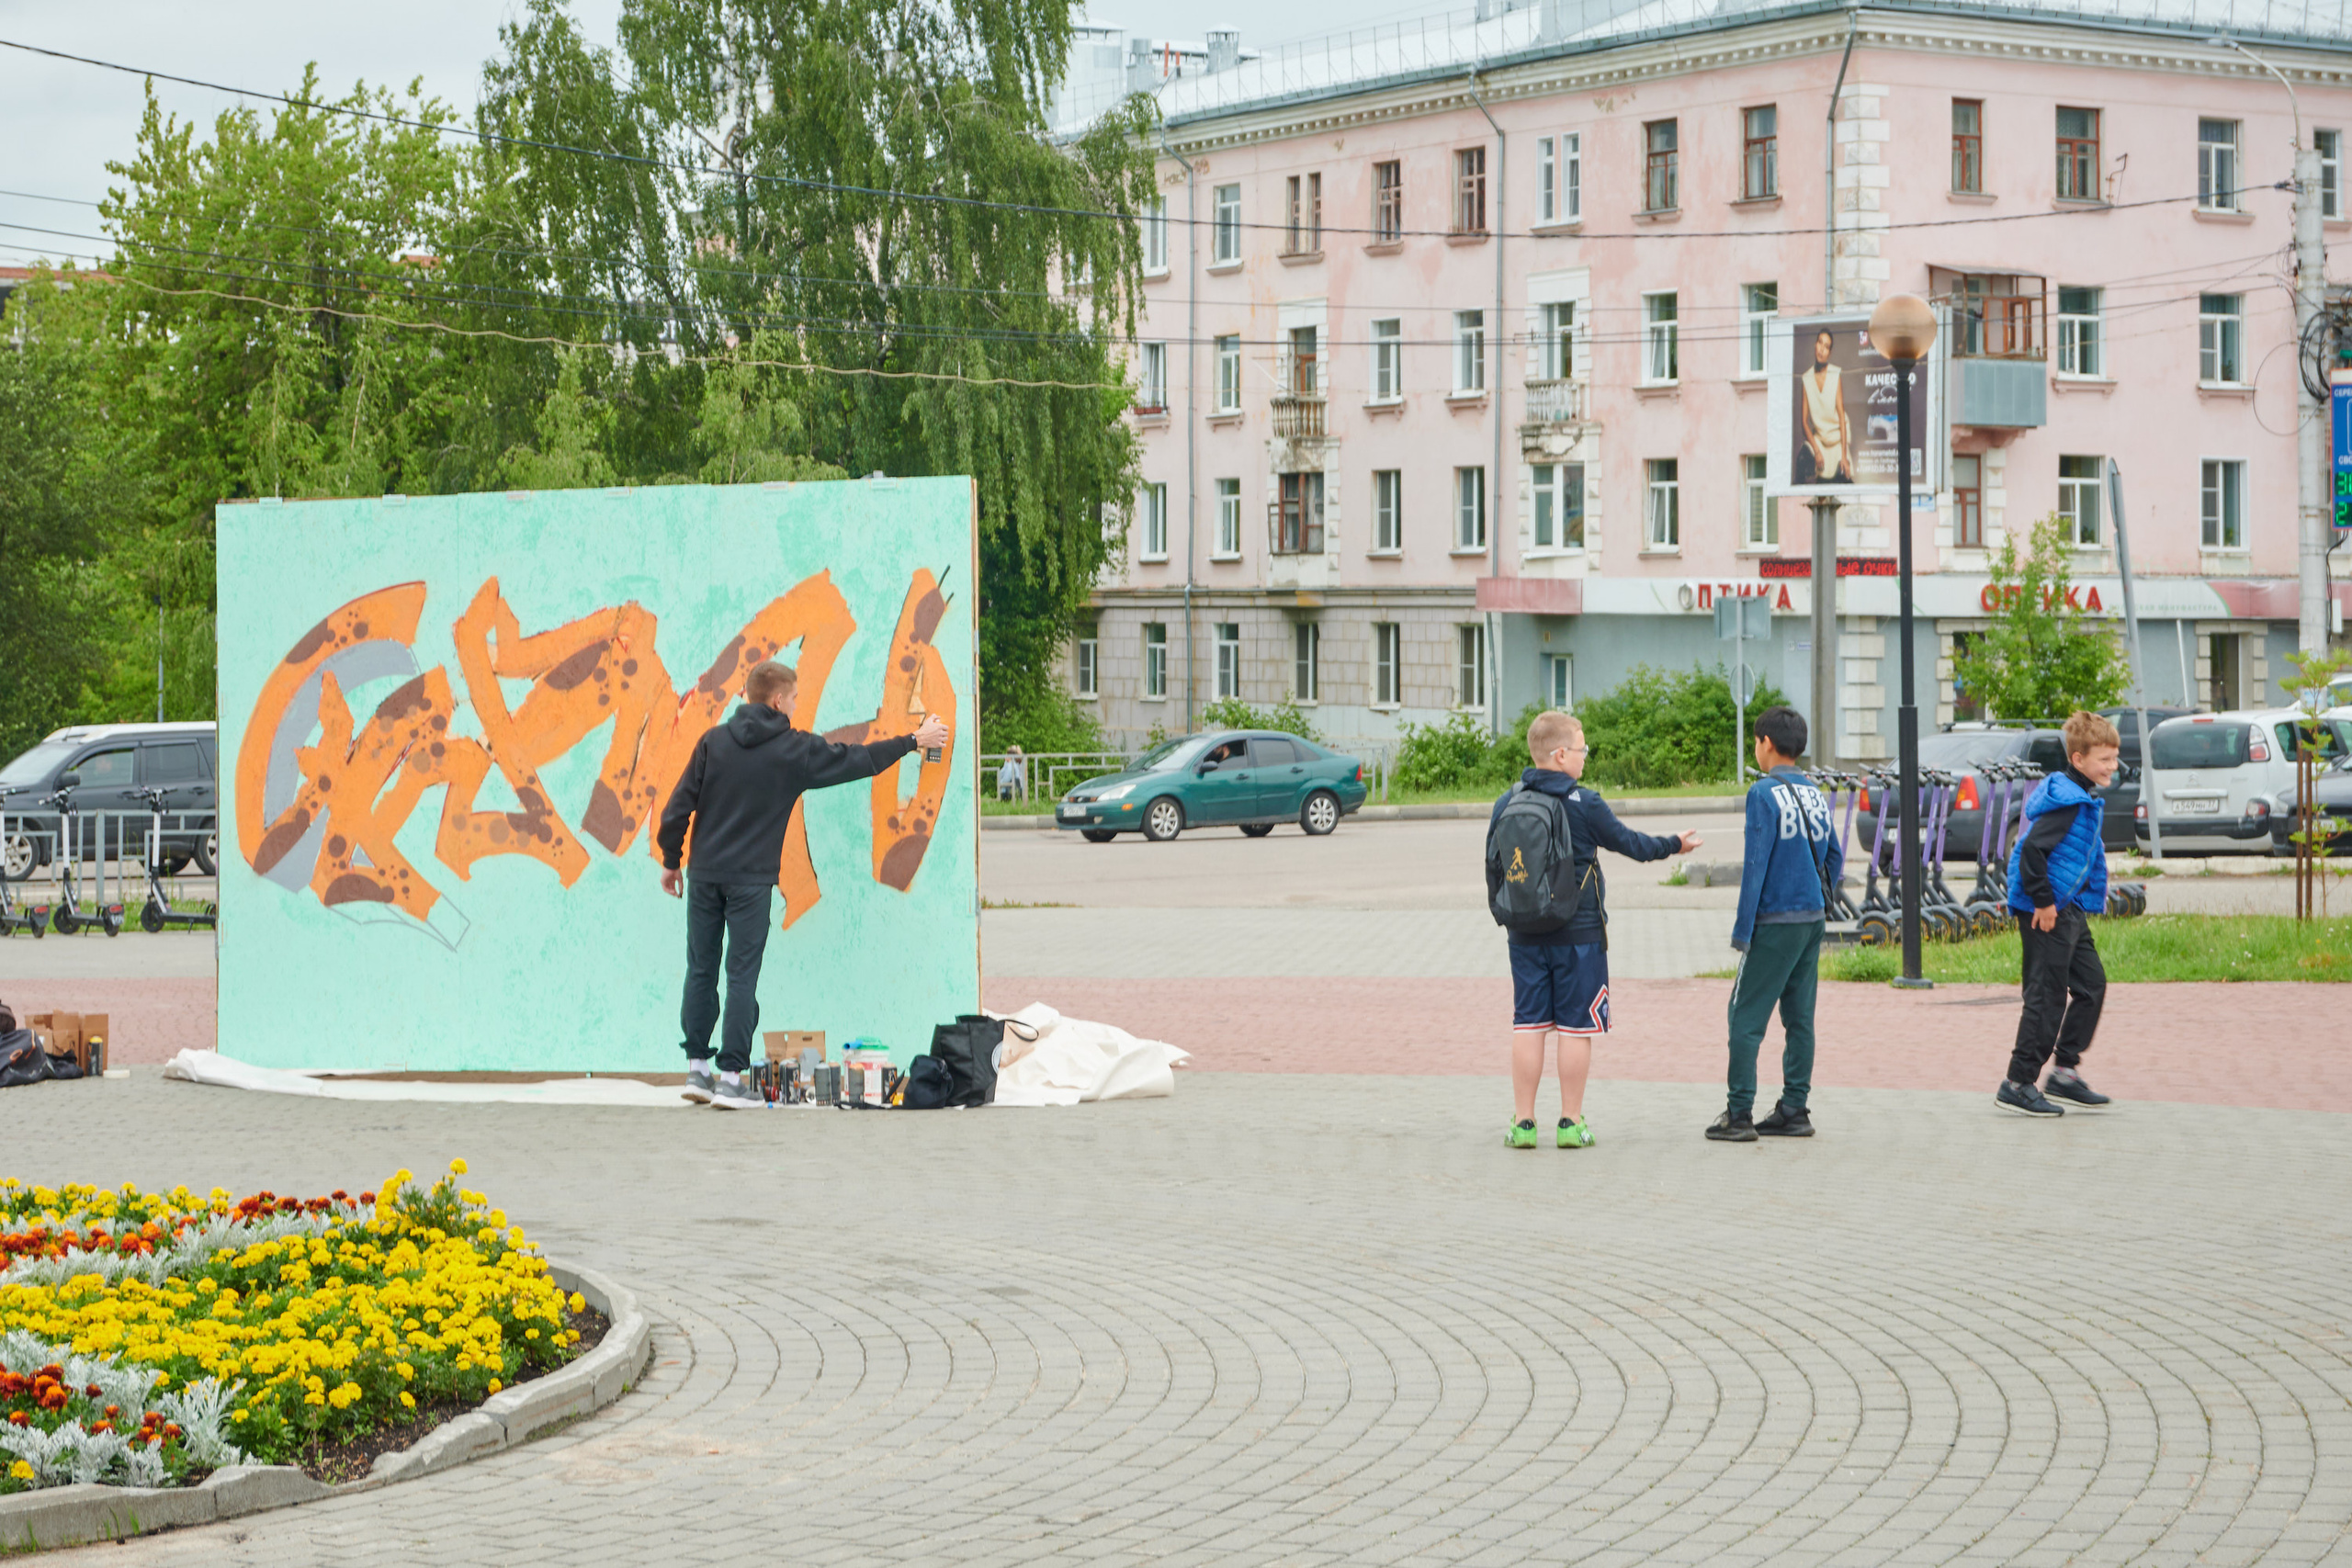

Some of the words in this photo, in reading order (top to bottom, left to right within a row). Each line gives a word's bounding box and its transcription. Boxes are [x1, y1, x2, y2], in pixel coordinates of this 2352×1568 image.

[1865, 372, 1917, 387] КАЧЕСО
[1678, 583, 1792, 611] ОПТИКА
[1981, 584, 2102, 612] ОПИКА
